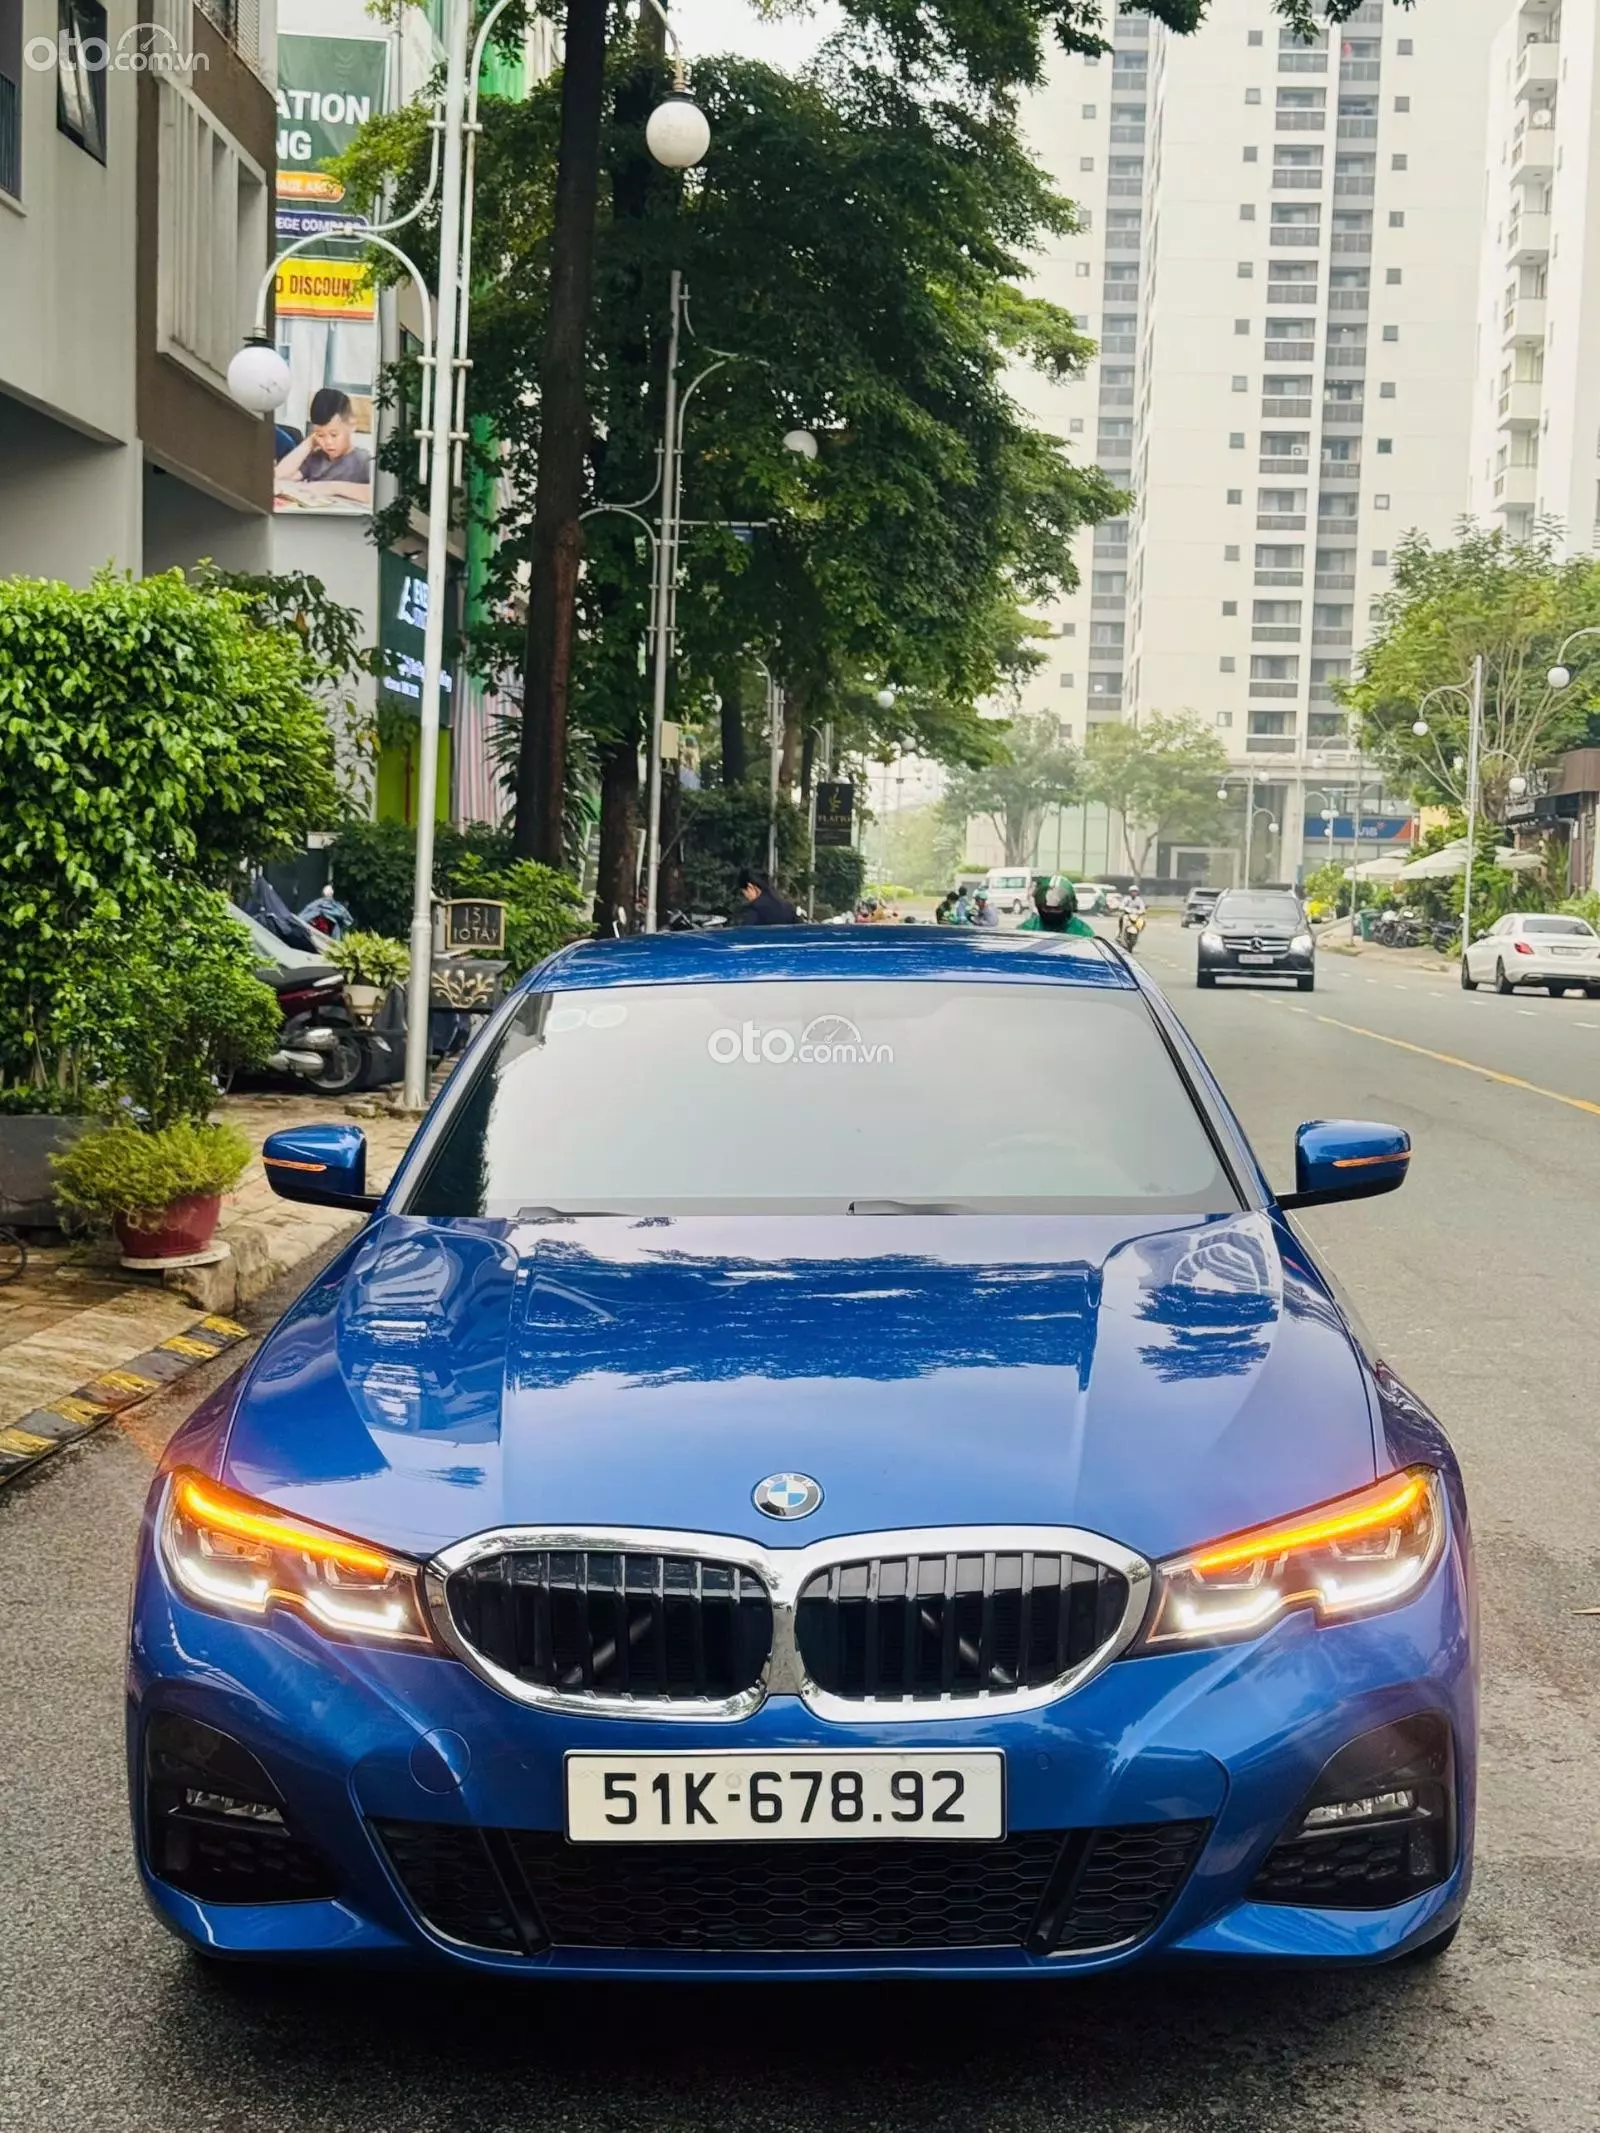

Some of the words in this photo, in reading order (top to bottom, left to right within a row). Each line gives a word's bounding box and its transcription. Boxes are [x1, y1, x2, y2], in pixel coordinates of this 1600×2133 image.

[276, 88, 370, 125] ATION
[290, 275, 361, 298] DISCOUN
[604, 1770, 965, 1825] 51K-678.92
